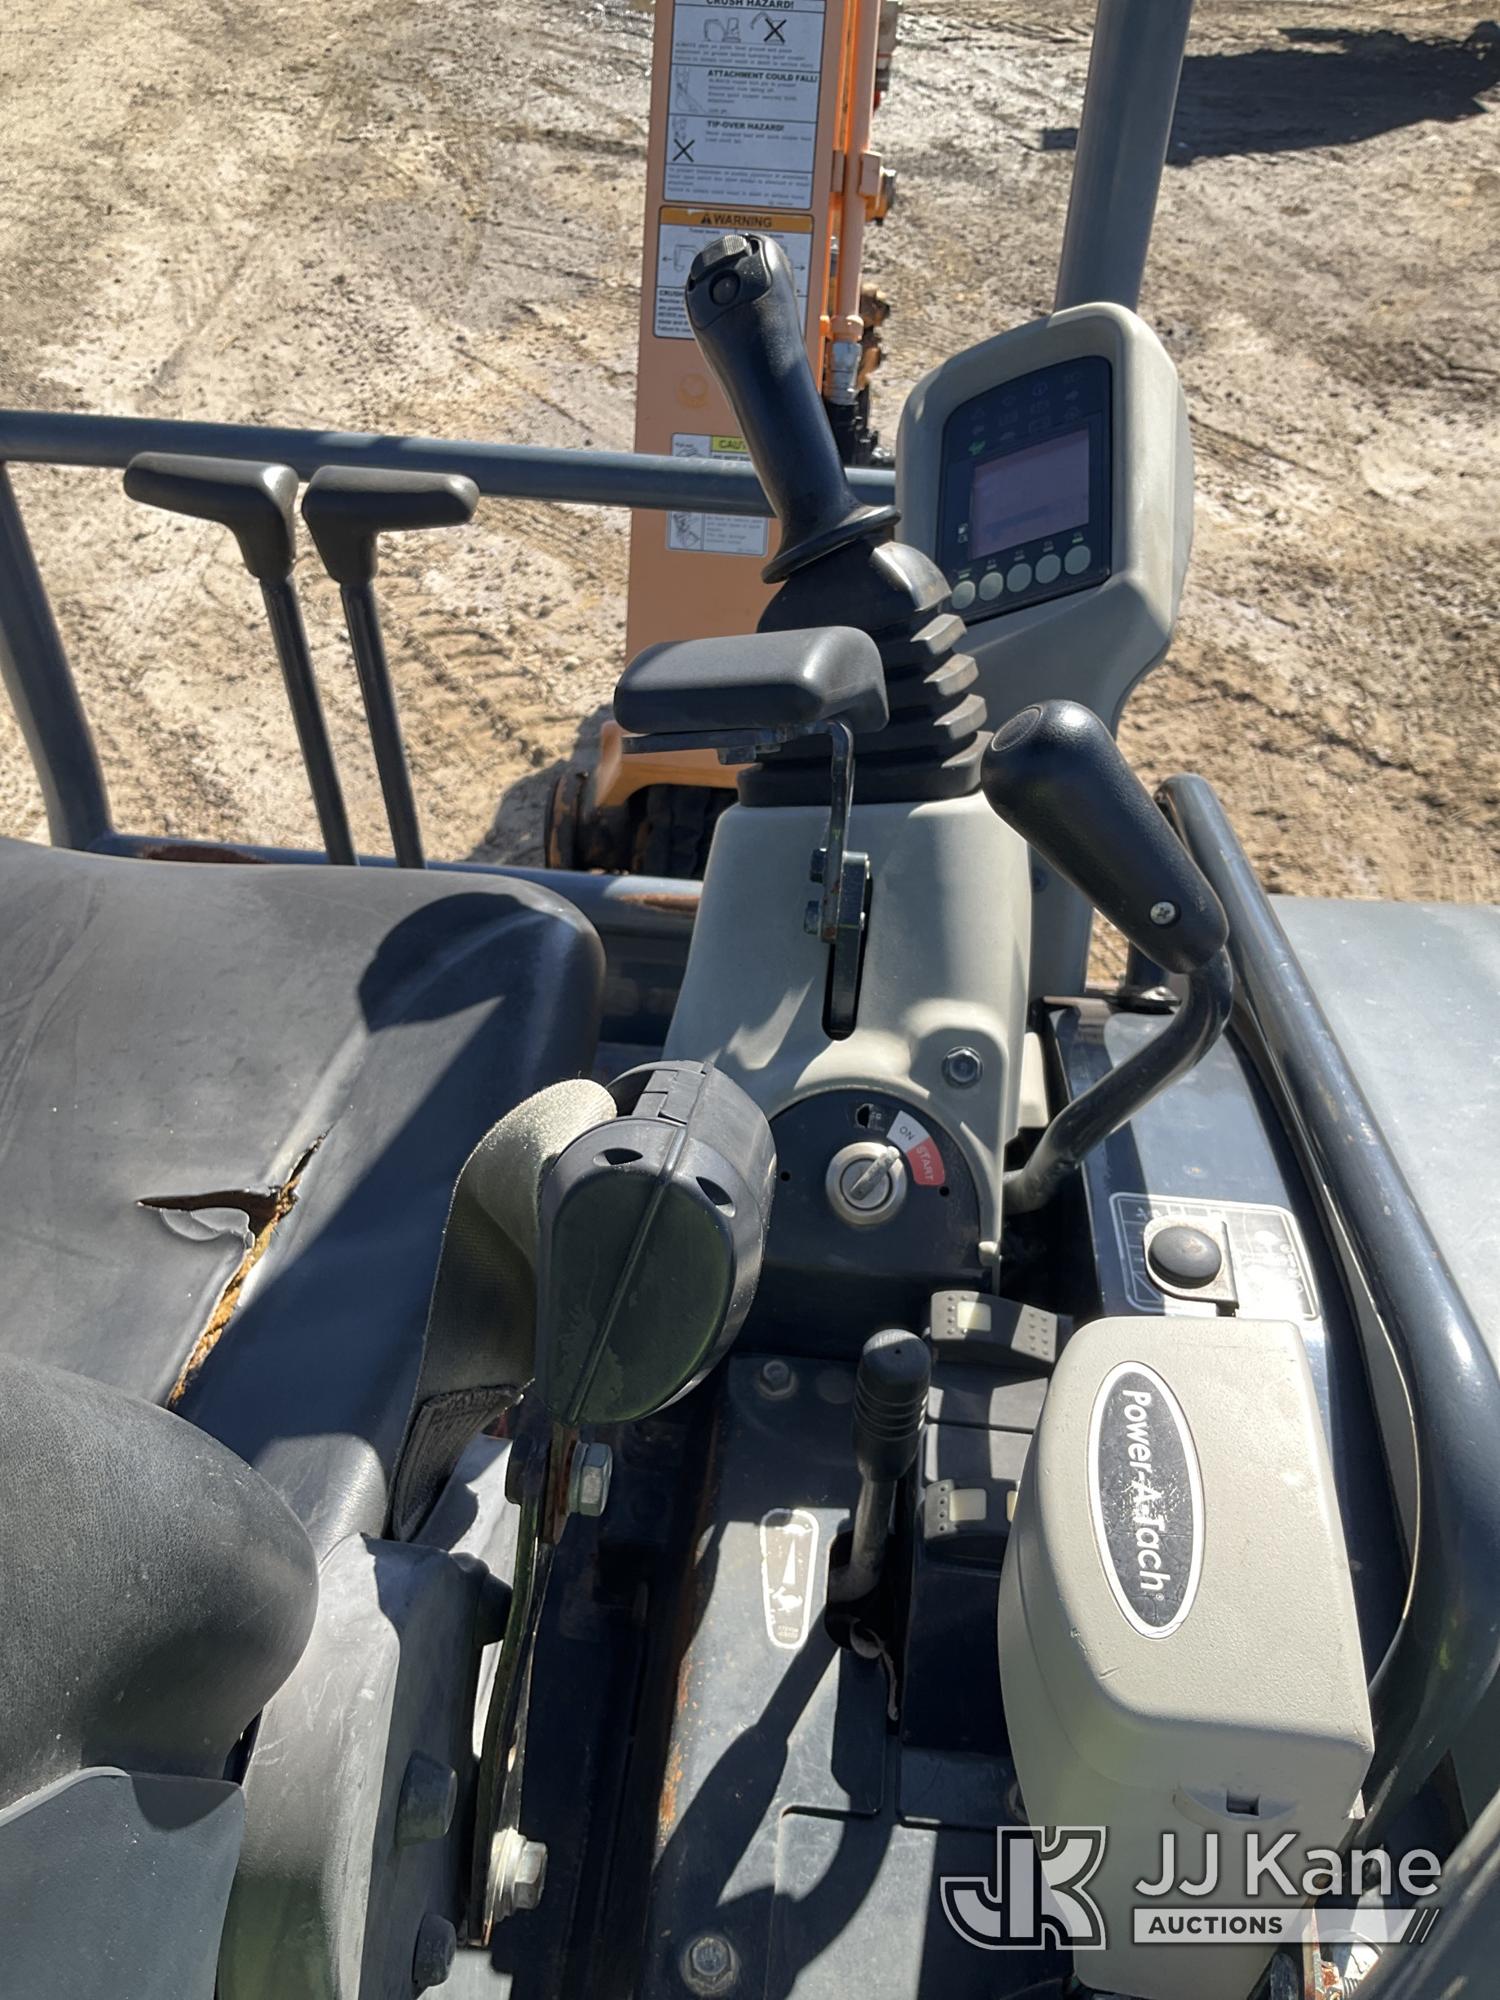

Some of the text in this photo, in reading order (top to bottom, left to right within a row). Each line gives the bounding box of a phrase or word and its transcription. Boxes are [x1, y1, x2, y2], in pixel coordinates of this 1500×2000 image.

[707, 69, 764, 80] ATTACHMENT
[765, 72, 794, 81] COULD
[707, 120, 747, 130] TIP-OVER
[713, 213, 772, 228] WARNING
[899, 1126, 916, 1141] ON
[916, 1145, 934, 1181] START
